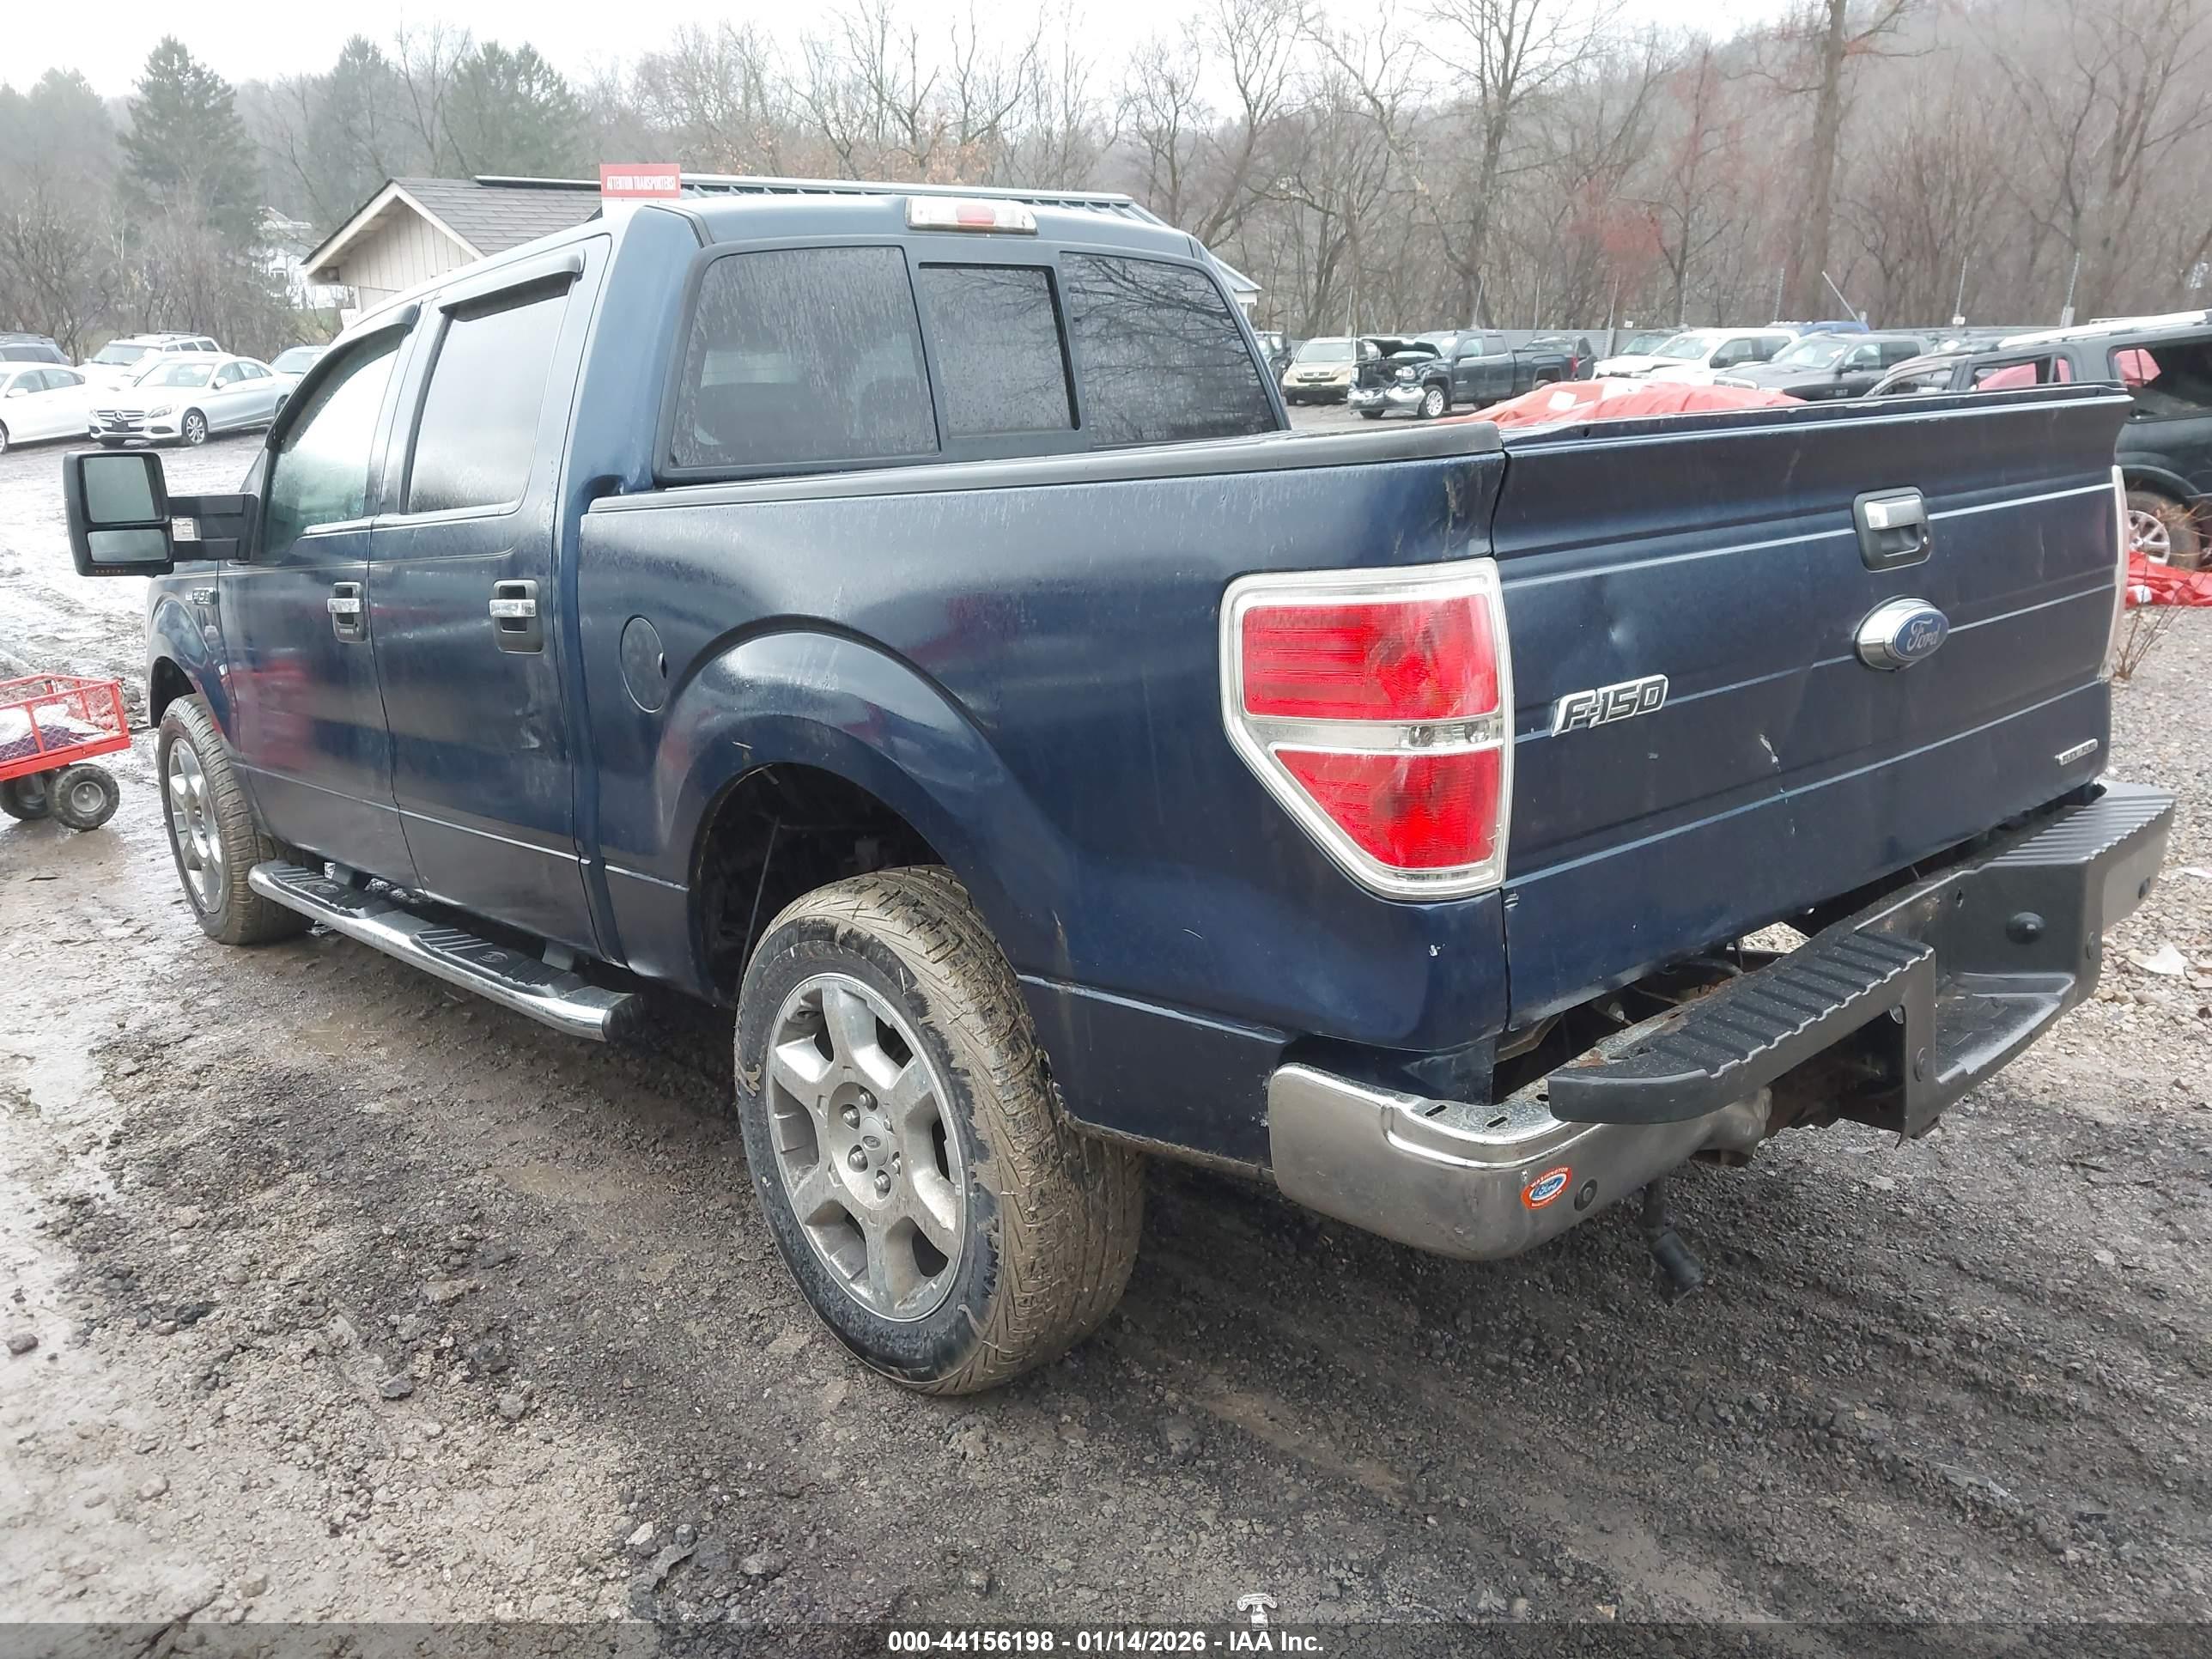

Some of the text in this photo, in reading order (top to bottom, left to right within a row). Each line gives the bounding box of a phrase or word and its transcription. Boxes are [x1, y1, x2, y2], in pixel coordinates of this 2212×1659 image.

[1906, 618, 1942, 653] Ford
[1551, 673, 1669, 738] F-150
[1530, 1167, 1569, 1188] WASHINGTON
[1538, 1179, 1559, 1195] Ford
